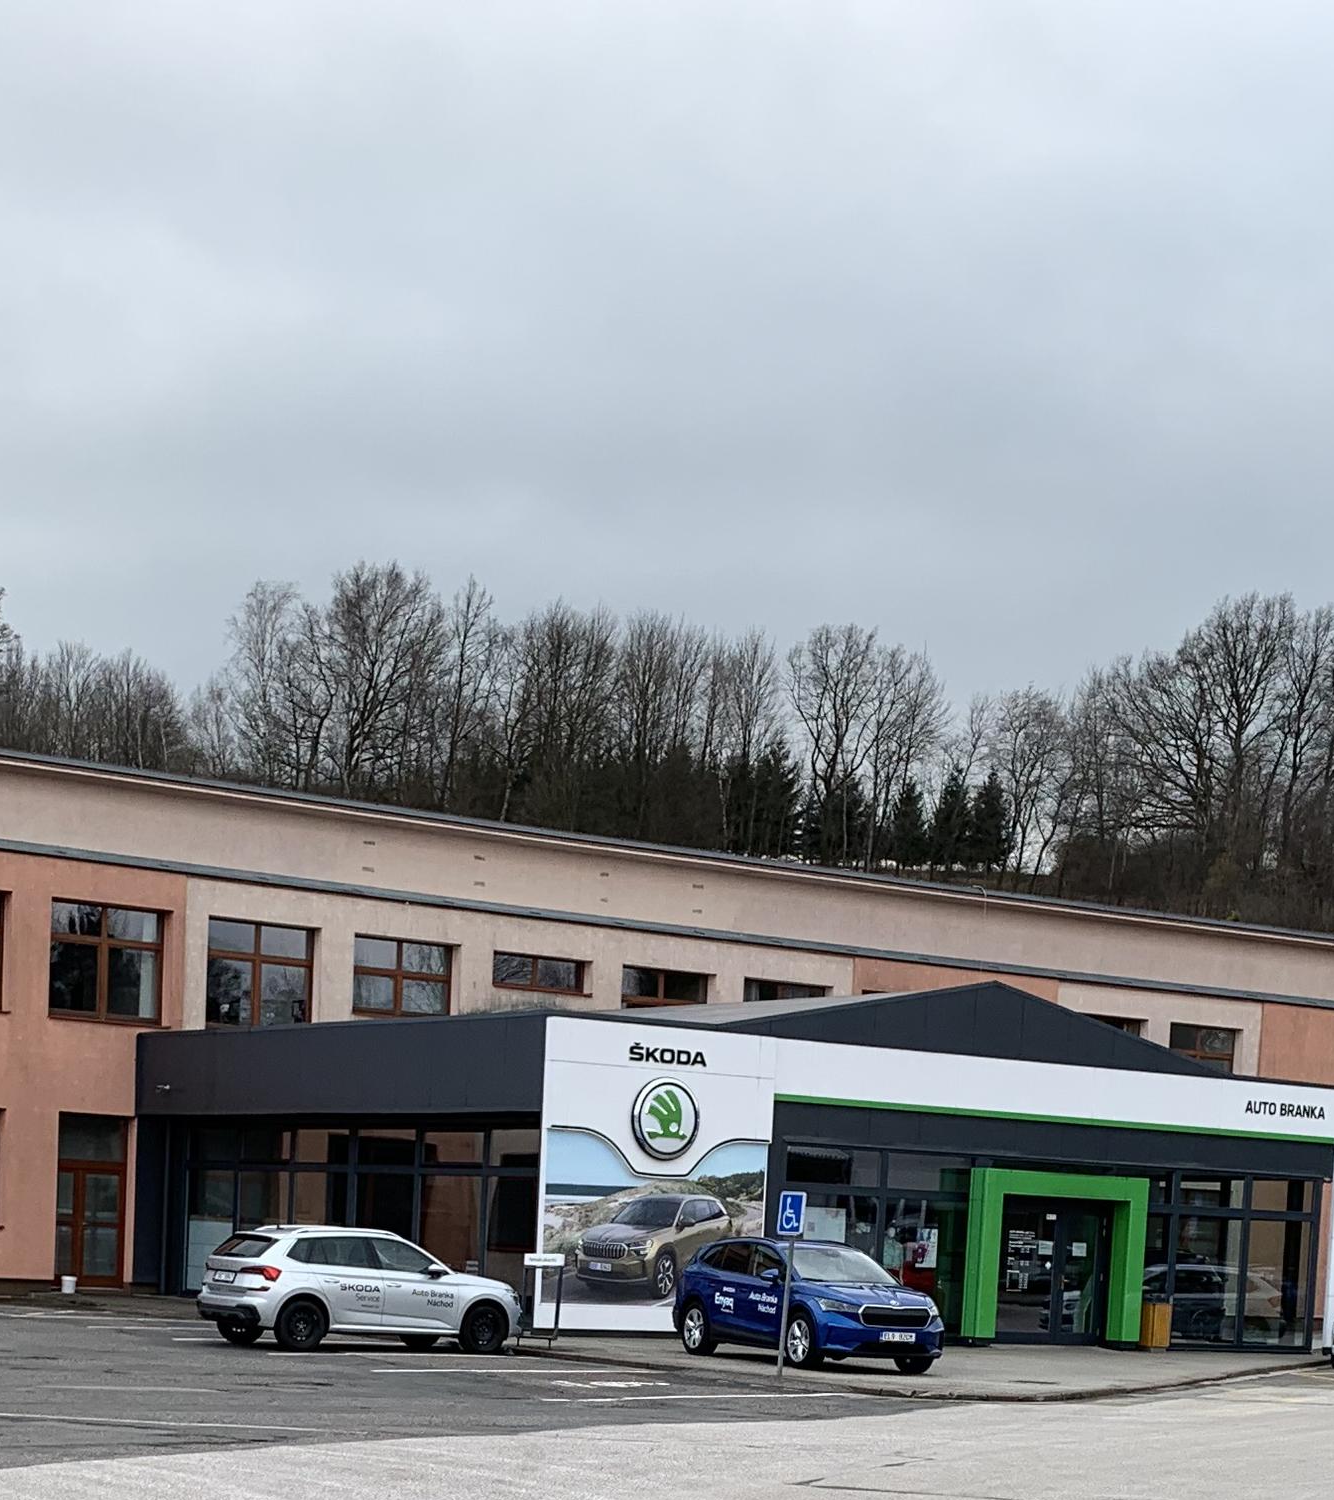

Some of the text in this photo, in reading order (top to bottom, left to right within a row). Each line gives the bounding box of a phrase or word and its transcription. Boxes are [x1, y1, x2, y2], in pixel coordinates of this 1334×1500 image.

[629, 1042, 707, 1068] ŠKODA
[1245, 1100, 1325, 1120] AUTO BRANKA
